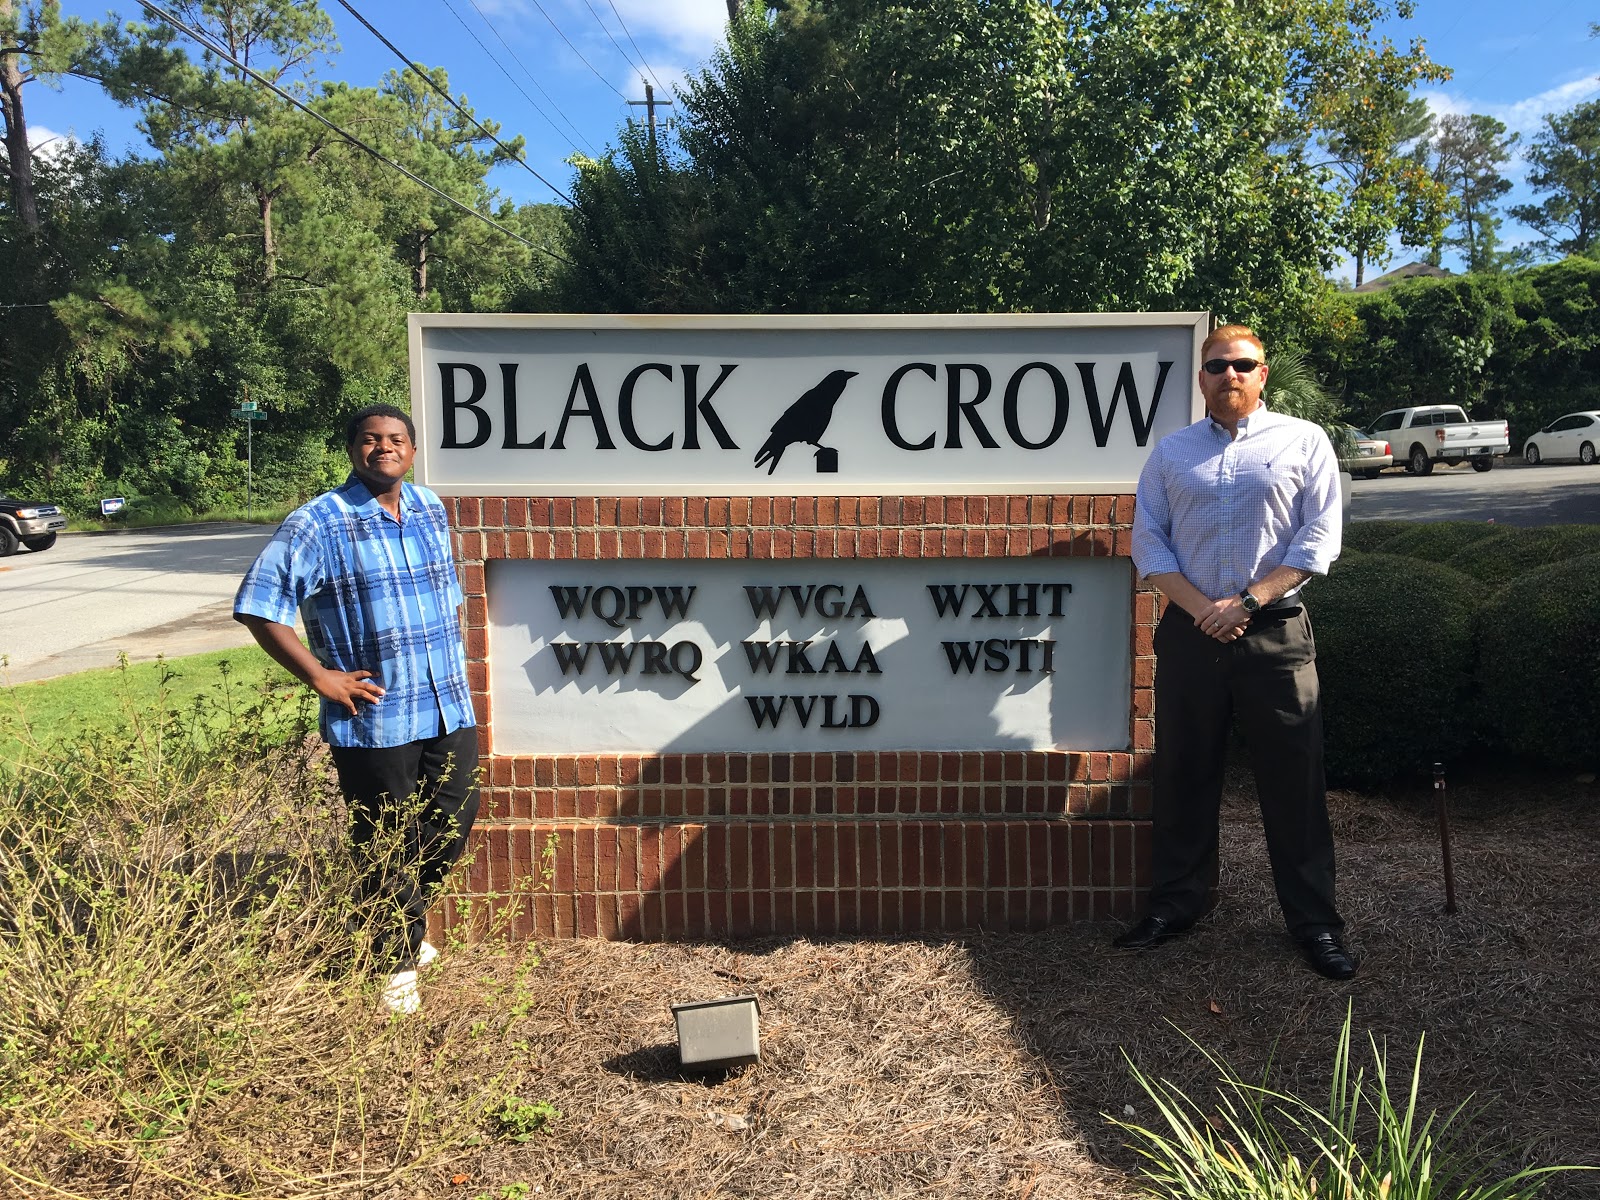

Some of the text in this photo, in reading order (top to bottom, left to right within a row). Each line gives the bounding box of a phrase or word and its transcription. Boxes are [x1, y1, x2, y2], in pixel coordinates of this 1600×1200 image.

[437, 361, 1174, 451] BLACK CROW
[549, 583, 1073, 627] WQPW WVGA WXHT
[549, 638, 1057, 683] WWRQ WKAA WSTI
[745, 694, 880, 729] WVLD
